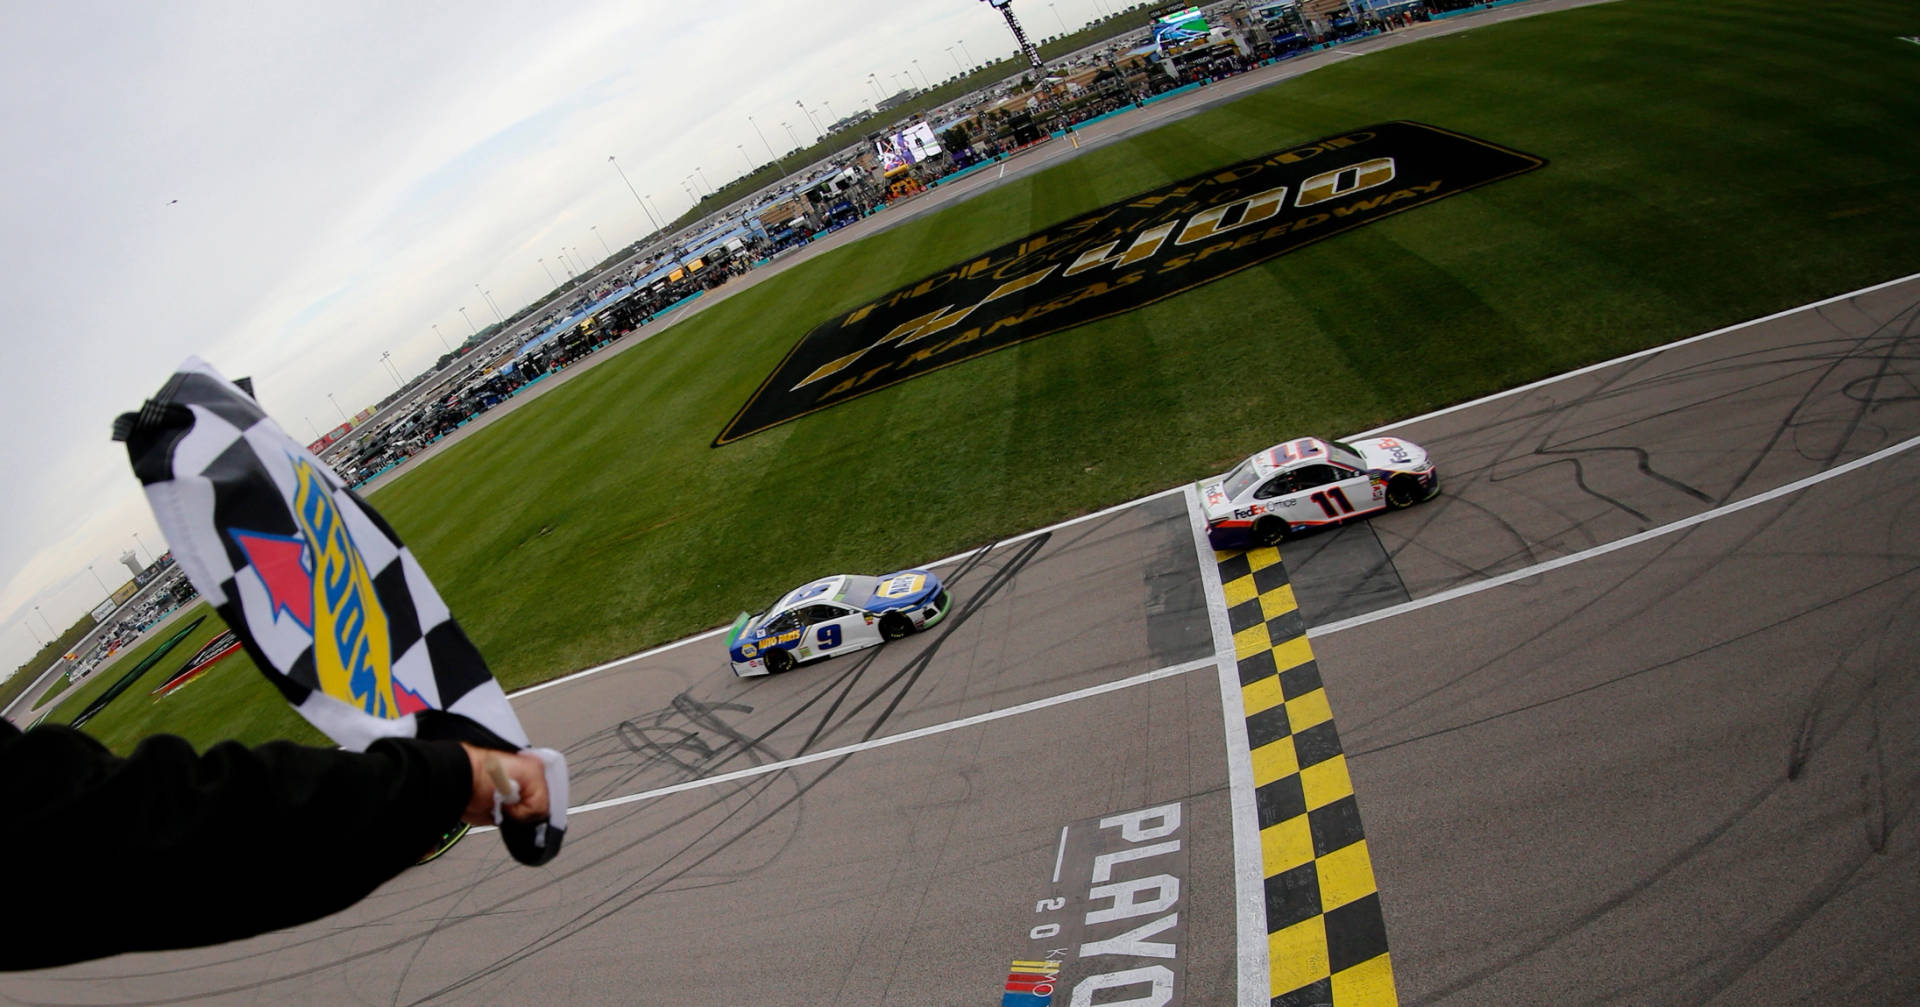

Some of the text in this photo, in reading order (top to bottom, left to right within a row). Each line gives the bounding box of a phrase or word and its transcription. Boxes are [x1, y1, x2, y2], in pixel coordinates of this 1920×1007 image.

[841, 132, 1376, 327] HOLLYWOOD
[1062, 156, 1396, 277] 400
[816, 179, 1442, 401] AT KANSAS SPEEDWAY
[1234, 504, 1267, 519] FedEx
[1310, 485, 1355, 518] 11
[303, 479, 394, 719] NOCO
[816, 623, 842, 651] 9
[758, 636, 777, 650] AUTO
